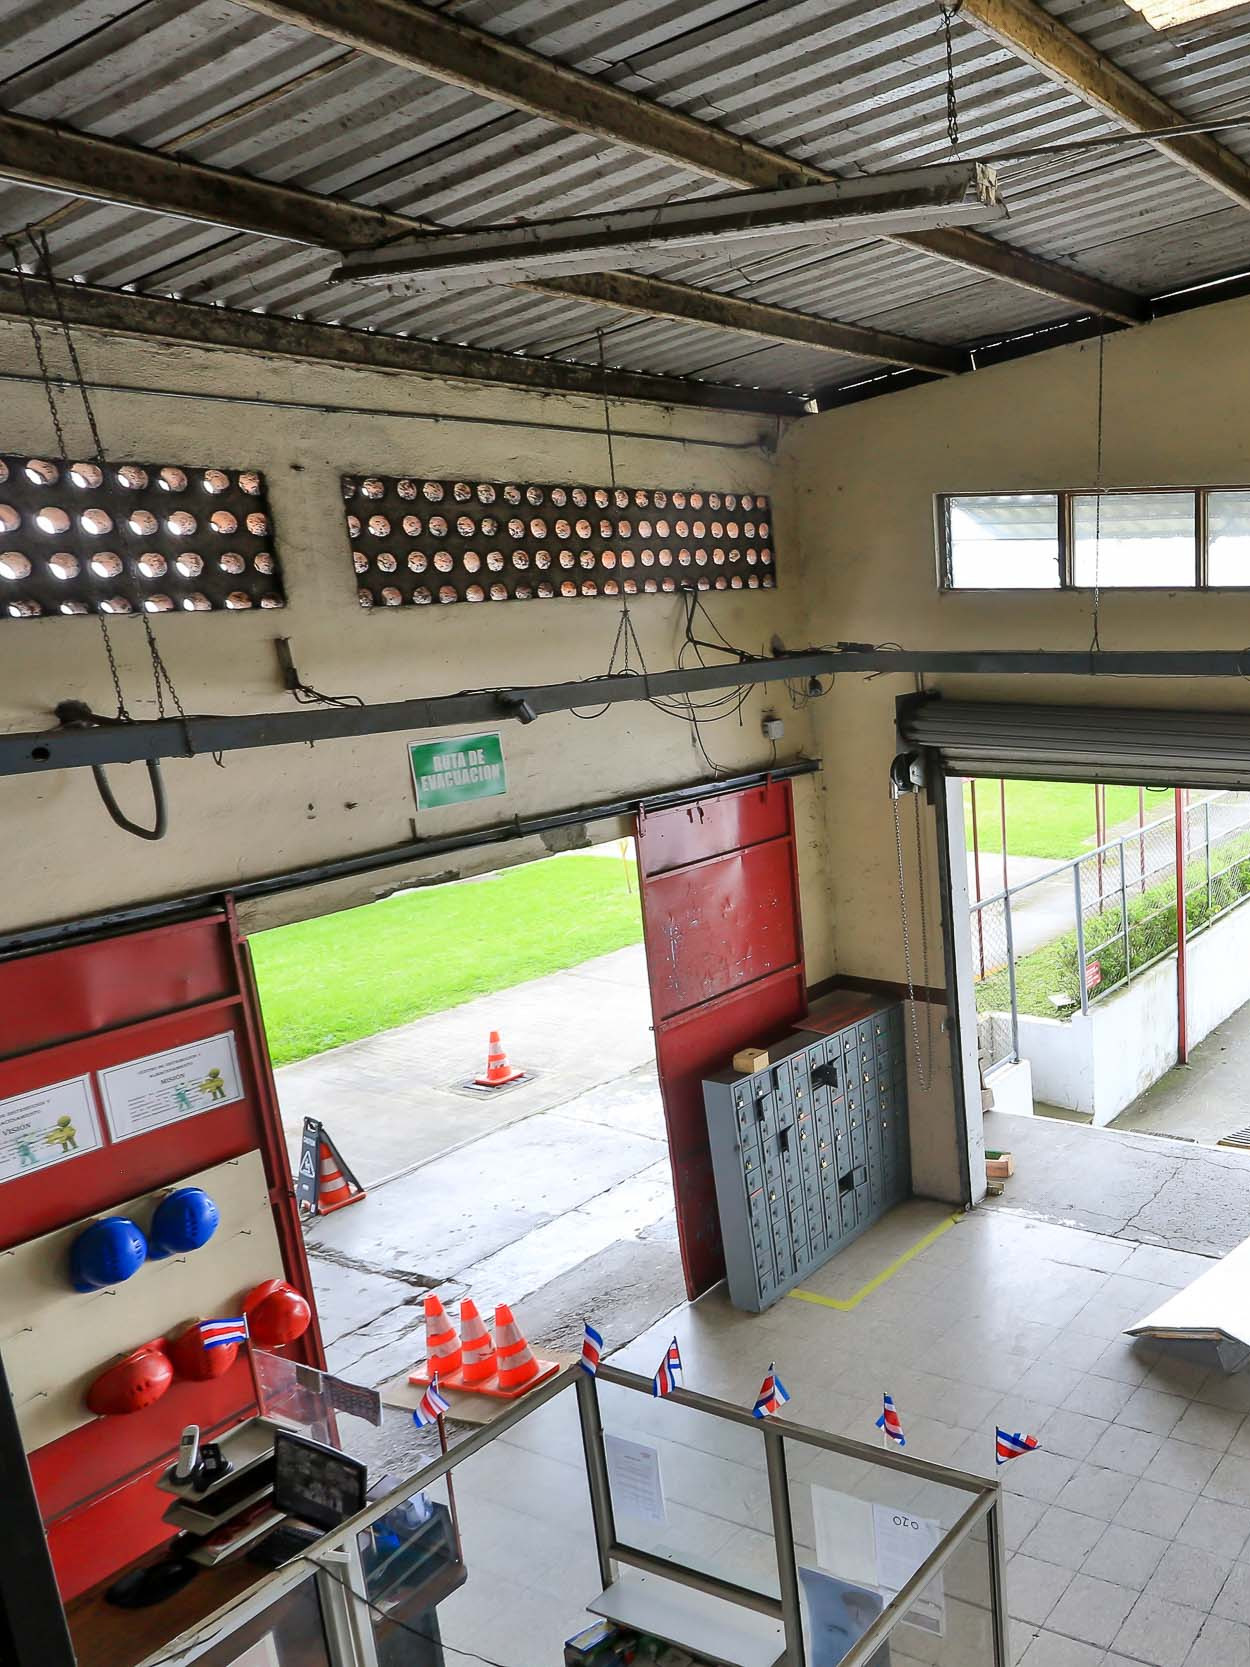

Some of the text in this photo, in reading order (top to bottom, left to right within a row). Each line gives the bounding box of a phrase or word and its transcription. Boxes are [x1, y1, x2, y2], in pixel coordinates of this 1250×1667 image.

[433, 749, 486, 771] RUTA DE
[421, 764, 500, 791] EVACUACION
